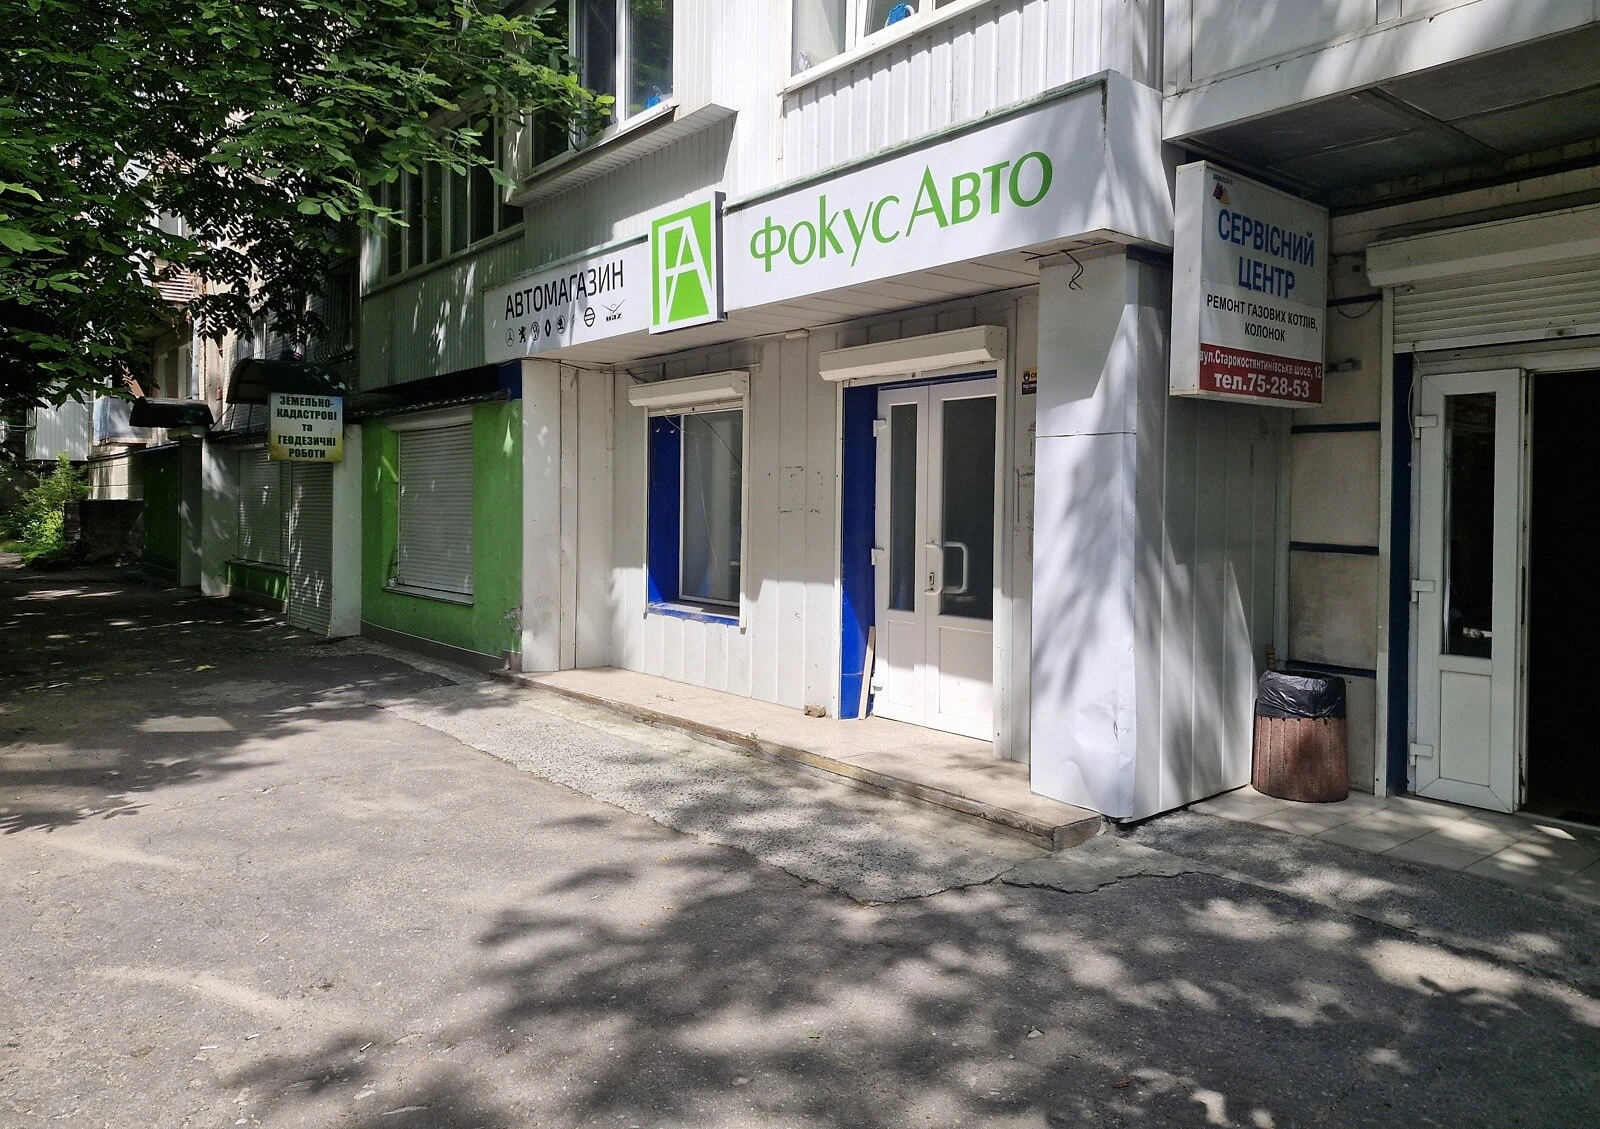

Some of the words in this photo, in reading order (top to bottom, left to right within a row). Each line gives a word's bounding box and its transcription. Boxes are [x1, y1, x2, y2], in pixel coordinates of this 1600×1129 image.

[1217, 208, 1315, 267] СЕРВІСНИЙ
[1238, 256, 1296, 299] ЦЕНТР
[504, 259, 624, 321] АВТОМАГАЗИН
[1206, 294, 1246, 314] РЕМОНТ
[1247, 303, 1287, 323] ГАЗОВИХ
[1288, 312, 1318, 332] КОТЛІВ,
[1244, 322, 1286, 342] КОЛОНОК
[279, 395, 334, 408] ЗЕМЕЛЬНО-
[276, 408, 337, 420] КАДАСТРОВІ
[302, 424, 313, 432] та
[278, 435, 336, 446] ГЕОДЕЗИЧНІ
[288, 448, 326, 459] РОБОТИ
